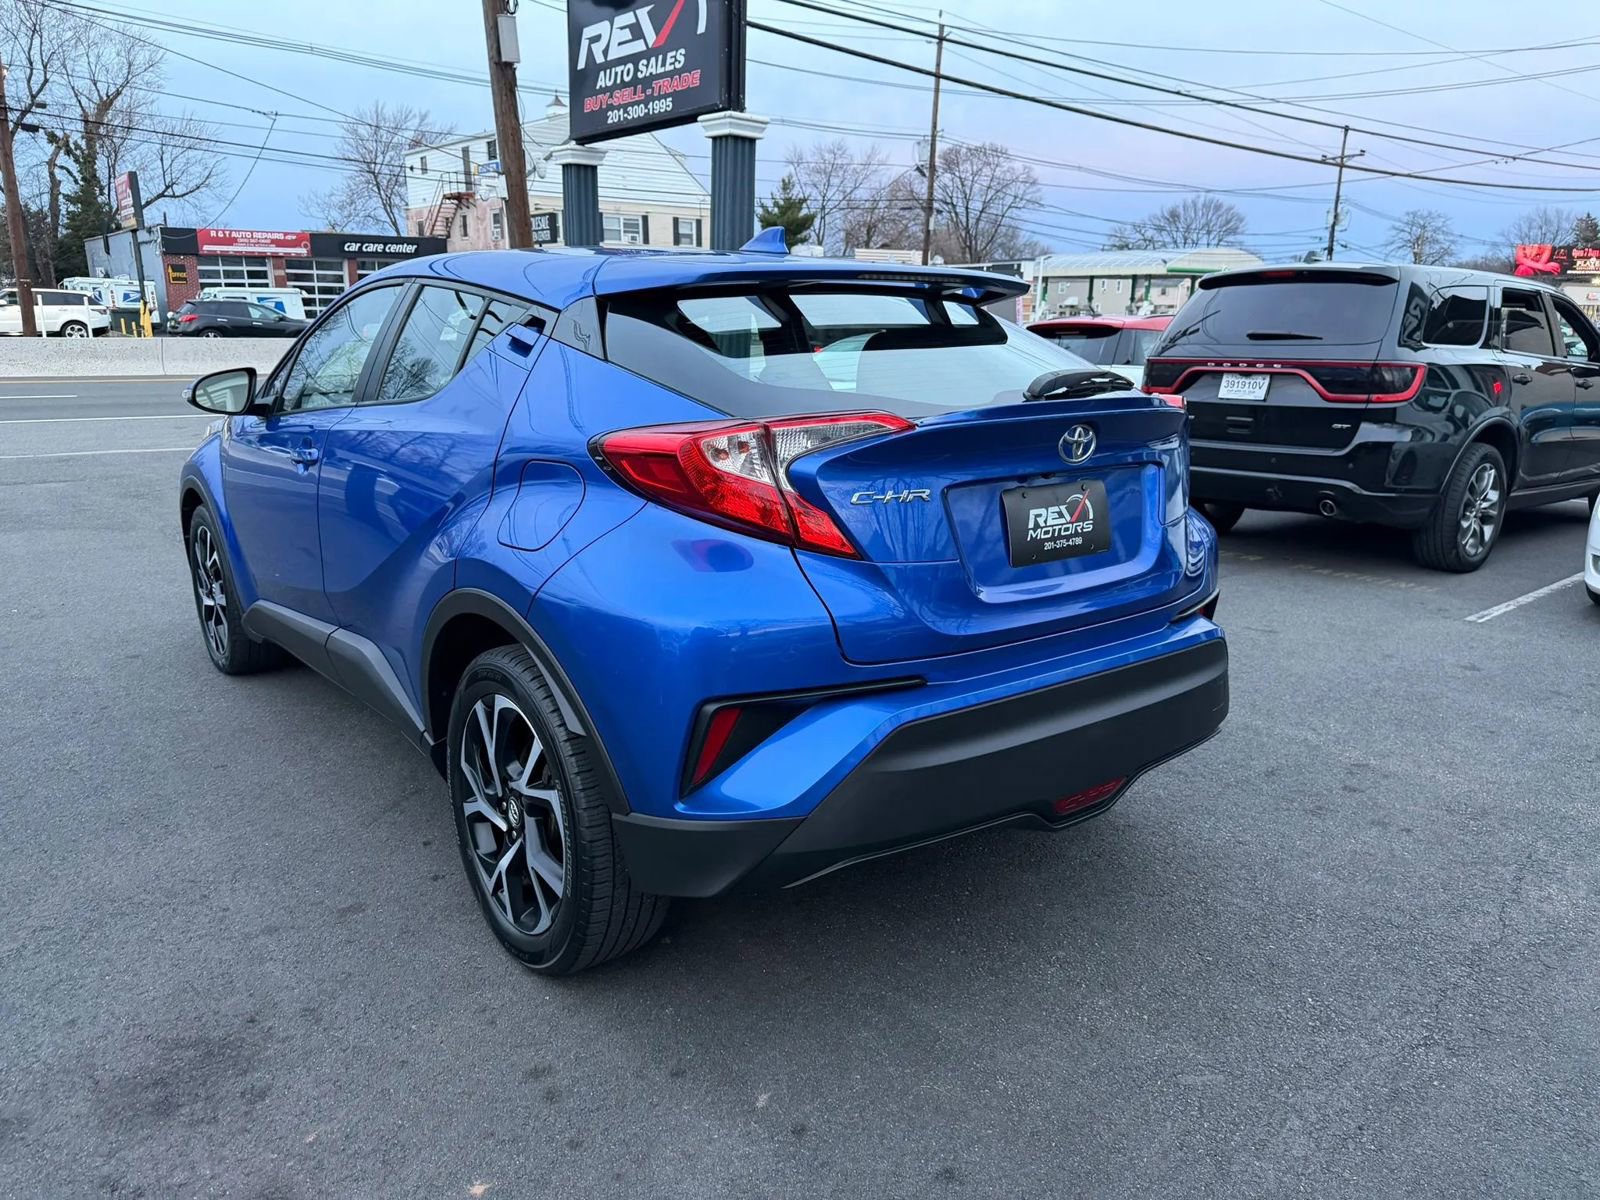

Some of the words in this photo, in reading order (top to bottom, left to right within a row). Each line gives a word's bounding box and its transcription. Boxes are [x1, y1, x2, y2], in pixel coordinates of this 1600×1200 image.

[596, 63, 634, 89] AUTO
[638, 48, 686, 79] SALES
[607, 97, 673, 124] 201-300-1995
[253, 231, 284, 240] REPAIRS
[344, 242, 361, 252] car
[362, 243, 385, 253] care
[385, 243, 418, 254] center
[1223, 379, 1265, 391] 391910V
[850, 488, 931, 505] C-HR
[1028, 489, 1090, 529] REV
[1027, 520, 1094, 541] MOTORS
[1044, 537, 1083, 550] 201-375-4789
